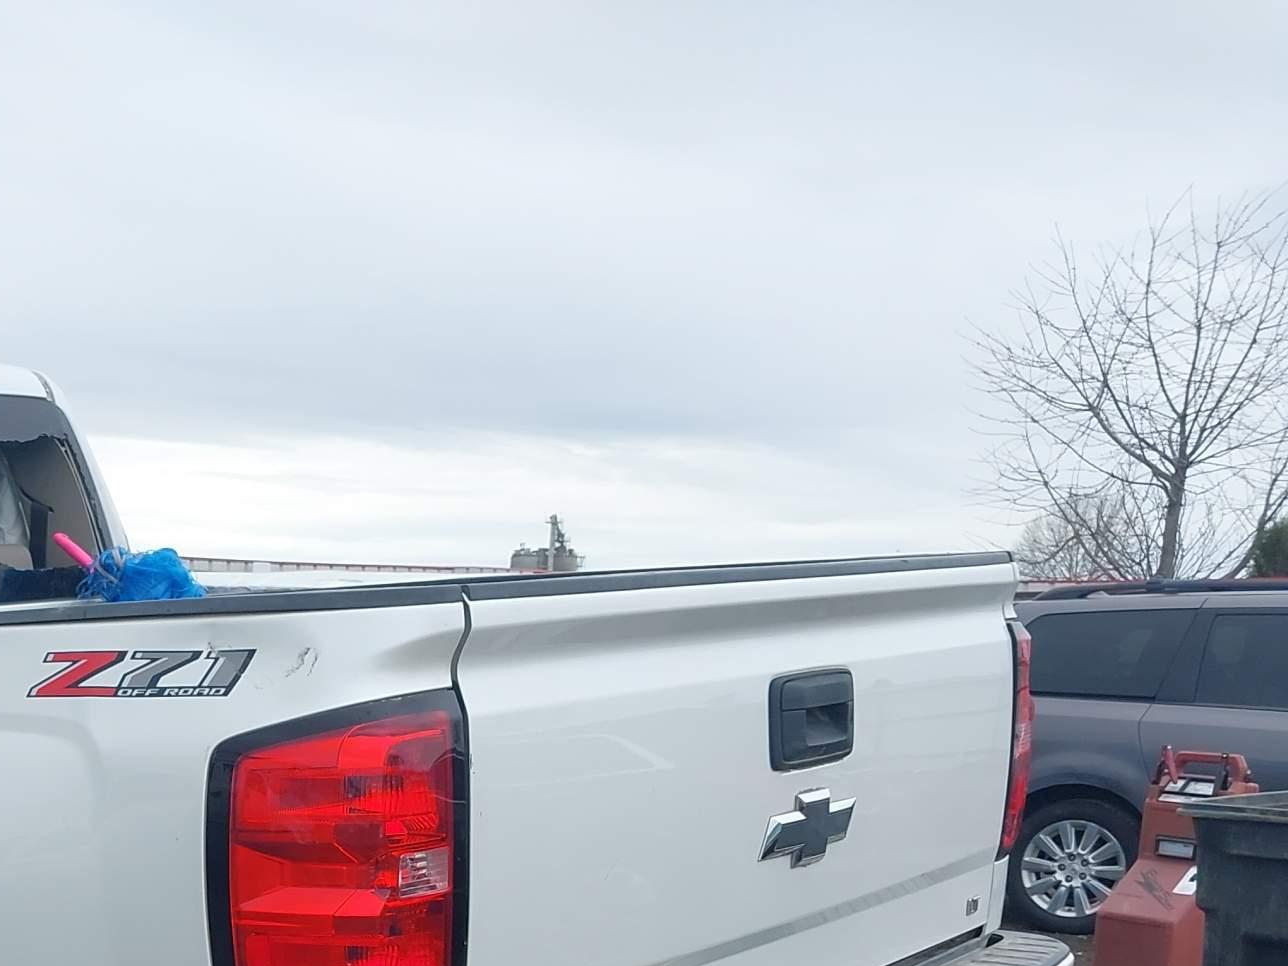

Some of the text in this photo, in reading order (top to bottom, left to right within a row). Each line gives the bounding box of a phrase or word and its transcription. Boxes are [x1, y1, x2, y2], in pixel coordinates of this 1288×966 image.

[26, 649, 257, 697] Z71
[117, 687, 226, 696] OFF ROAD
